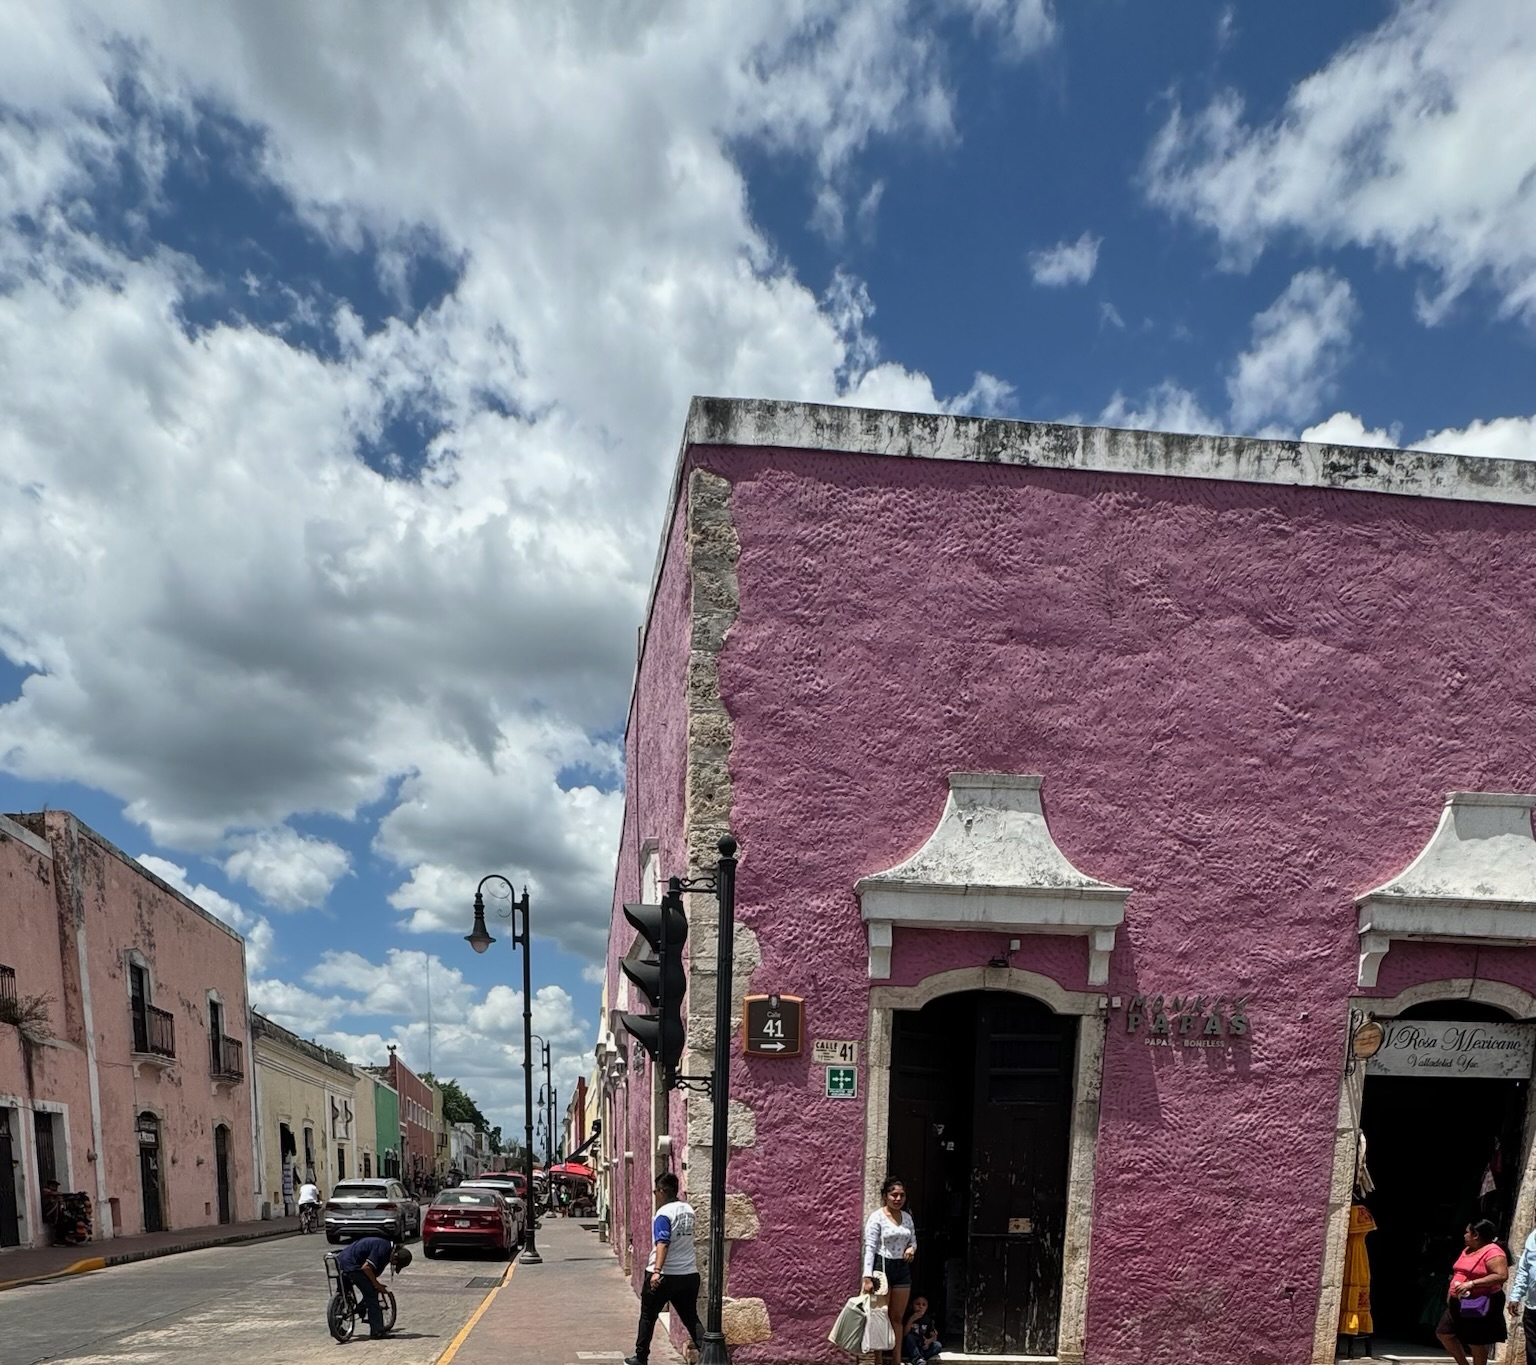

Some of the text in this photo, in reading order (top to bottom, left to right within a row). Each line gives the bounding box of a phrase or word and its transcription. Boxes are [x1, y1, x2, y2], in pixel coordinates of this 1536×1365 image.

[1128, 993, 1250, 1014] MONKEY
[763, 1019, 784, 1037] 41
[1127, 1013, 1249, 1035] PAPAS
[1144, 1038, 1172, 1046] PAPAS
[1184, 1039, 1225, 1048] BONELESS
[1394, 1025, 1437, 1050] Rosa
[1441, 1027, 1520, 1051] Mexicano
[815, 1041, 853, 1061] CALLE 41
